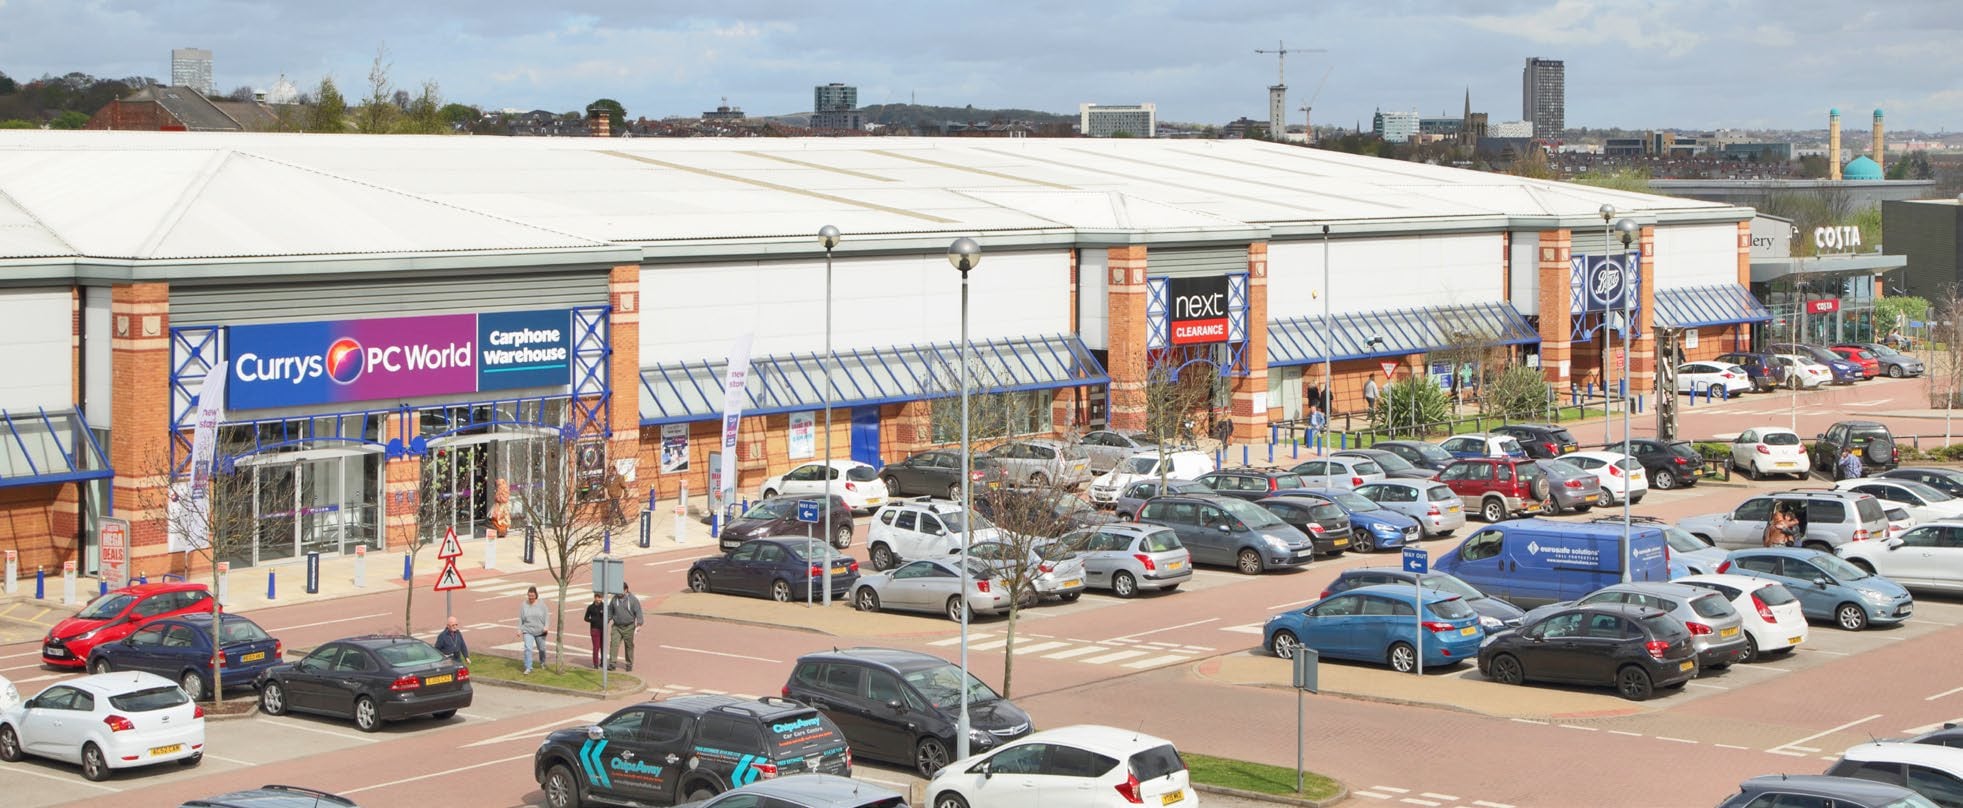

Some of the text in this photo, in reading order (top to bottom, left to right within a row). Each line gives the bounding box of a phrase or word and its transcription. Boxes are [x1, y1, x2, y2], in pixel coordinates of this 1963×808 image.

[1814, 226, 1861, 250] COSTA
[1176, 292, 1224, 318] next
[1816, 302, 1833, 311] COSTA
[489, 328, 561, 347] Carphone
[1176, 324, 1224, 338] CLEARANCE
[236, 341, 472, 385] Currys PC World
[483, 347, 567, 365] Warehouse
[103, 547, 123, 561] DEALS
[1540, 546, 1599, 556] eurosafe solutions
[773, 717, 820, 733] ChipsAway
[611, 757, 663, 777] ChipsAway
